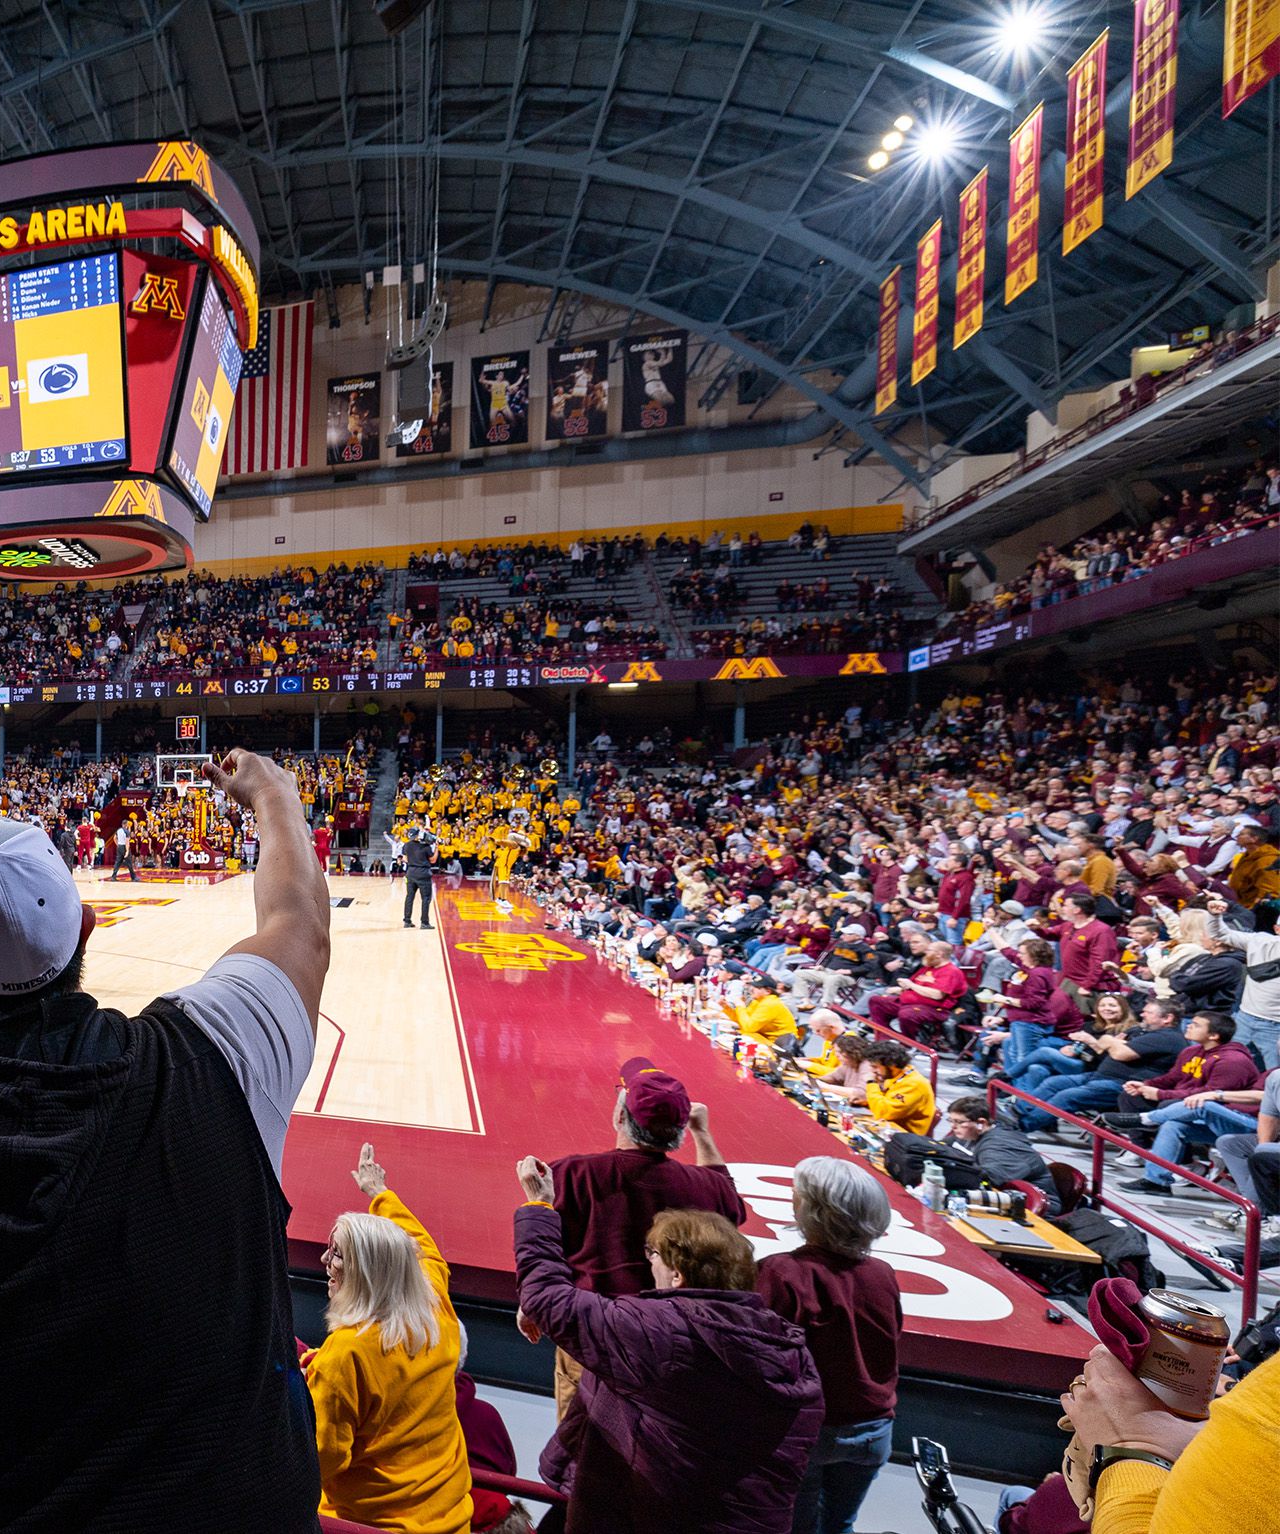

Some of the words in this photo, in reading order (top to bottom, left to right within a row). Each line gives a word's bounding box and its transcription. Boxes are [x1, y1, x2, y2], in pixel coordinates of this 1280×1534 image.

[1136, 71, 1167, 113] 2019
[27, 202, 127, 245] ARENA
[19, 272, 37, 281] PENN
[38, 267, 59, 277] STATE
[132, 273, 185, 320] M
[333, 381, 375, 393] THOMPSON
[564, 415, 588, 436] 52
[641, 408, 667, 428] 53
[486, 424, 511, 443] 45
[413, 437, 433, 452] 44
[10, 451, 30, 463] 6:37
[41, 449, 56, 462] 53
[342, 444, 362, 461] 43
[425, 672, 445, 680] MINN
[484, 670, 495, 678] 20
[507, 669, 517, 677] 30
[560, 666, 589, 678] Dutch
[176, 682, 192, 695] 44
[234, 680, 268, 694] 6:37
[312, 677, 330, 690] 53
[347, 681, 354, 690] 6
[371, 680, 377, 690] 1
[425, 680, 439, 688] PSU
[485, 679, 494, 687] 12
[507, 678, 517, 686] 33
[135, 689, 142, 698] 2
[155, 688, 161, 697] 6
[181, 725, 195, 737] 30
[184, 851, 210, 865] Cub
[1, 966, 59, 992] MINNESOTA
